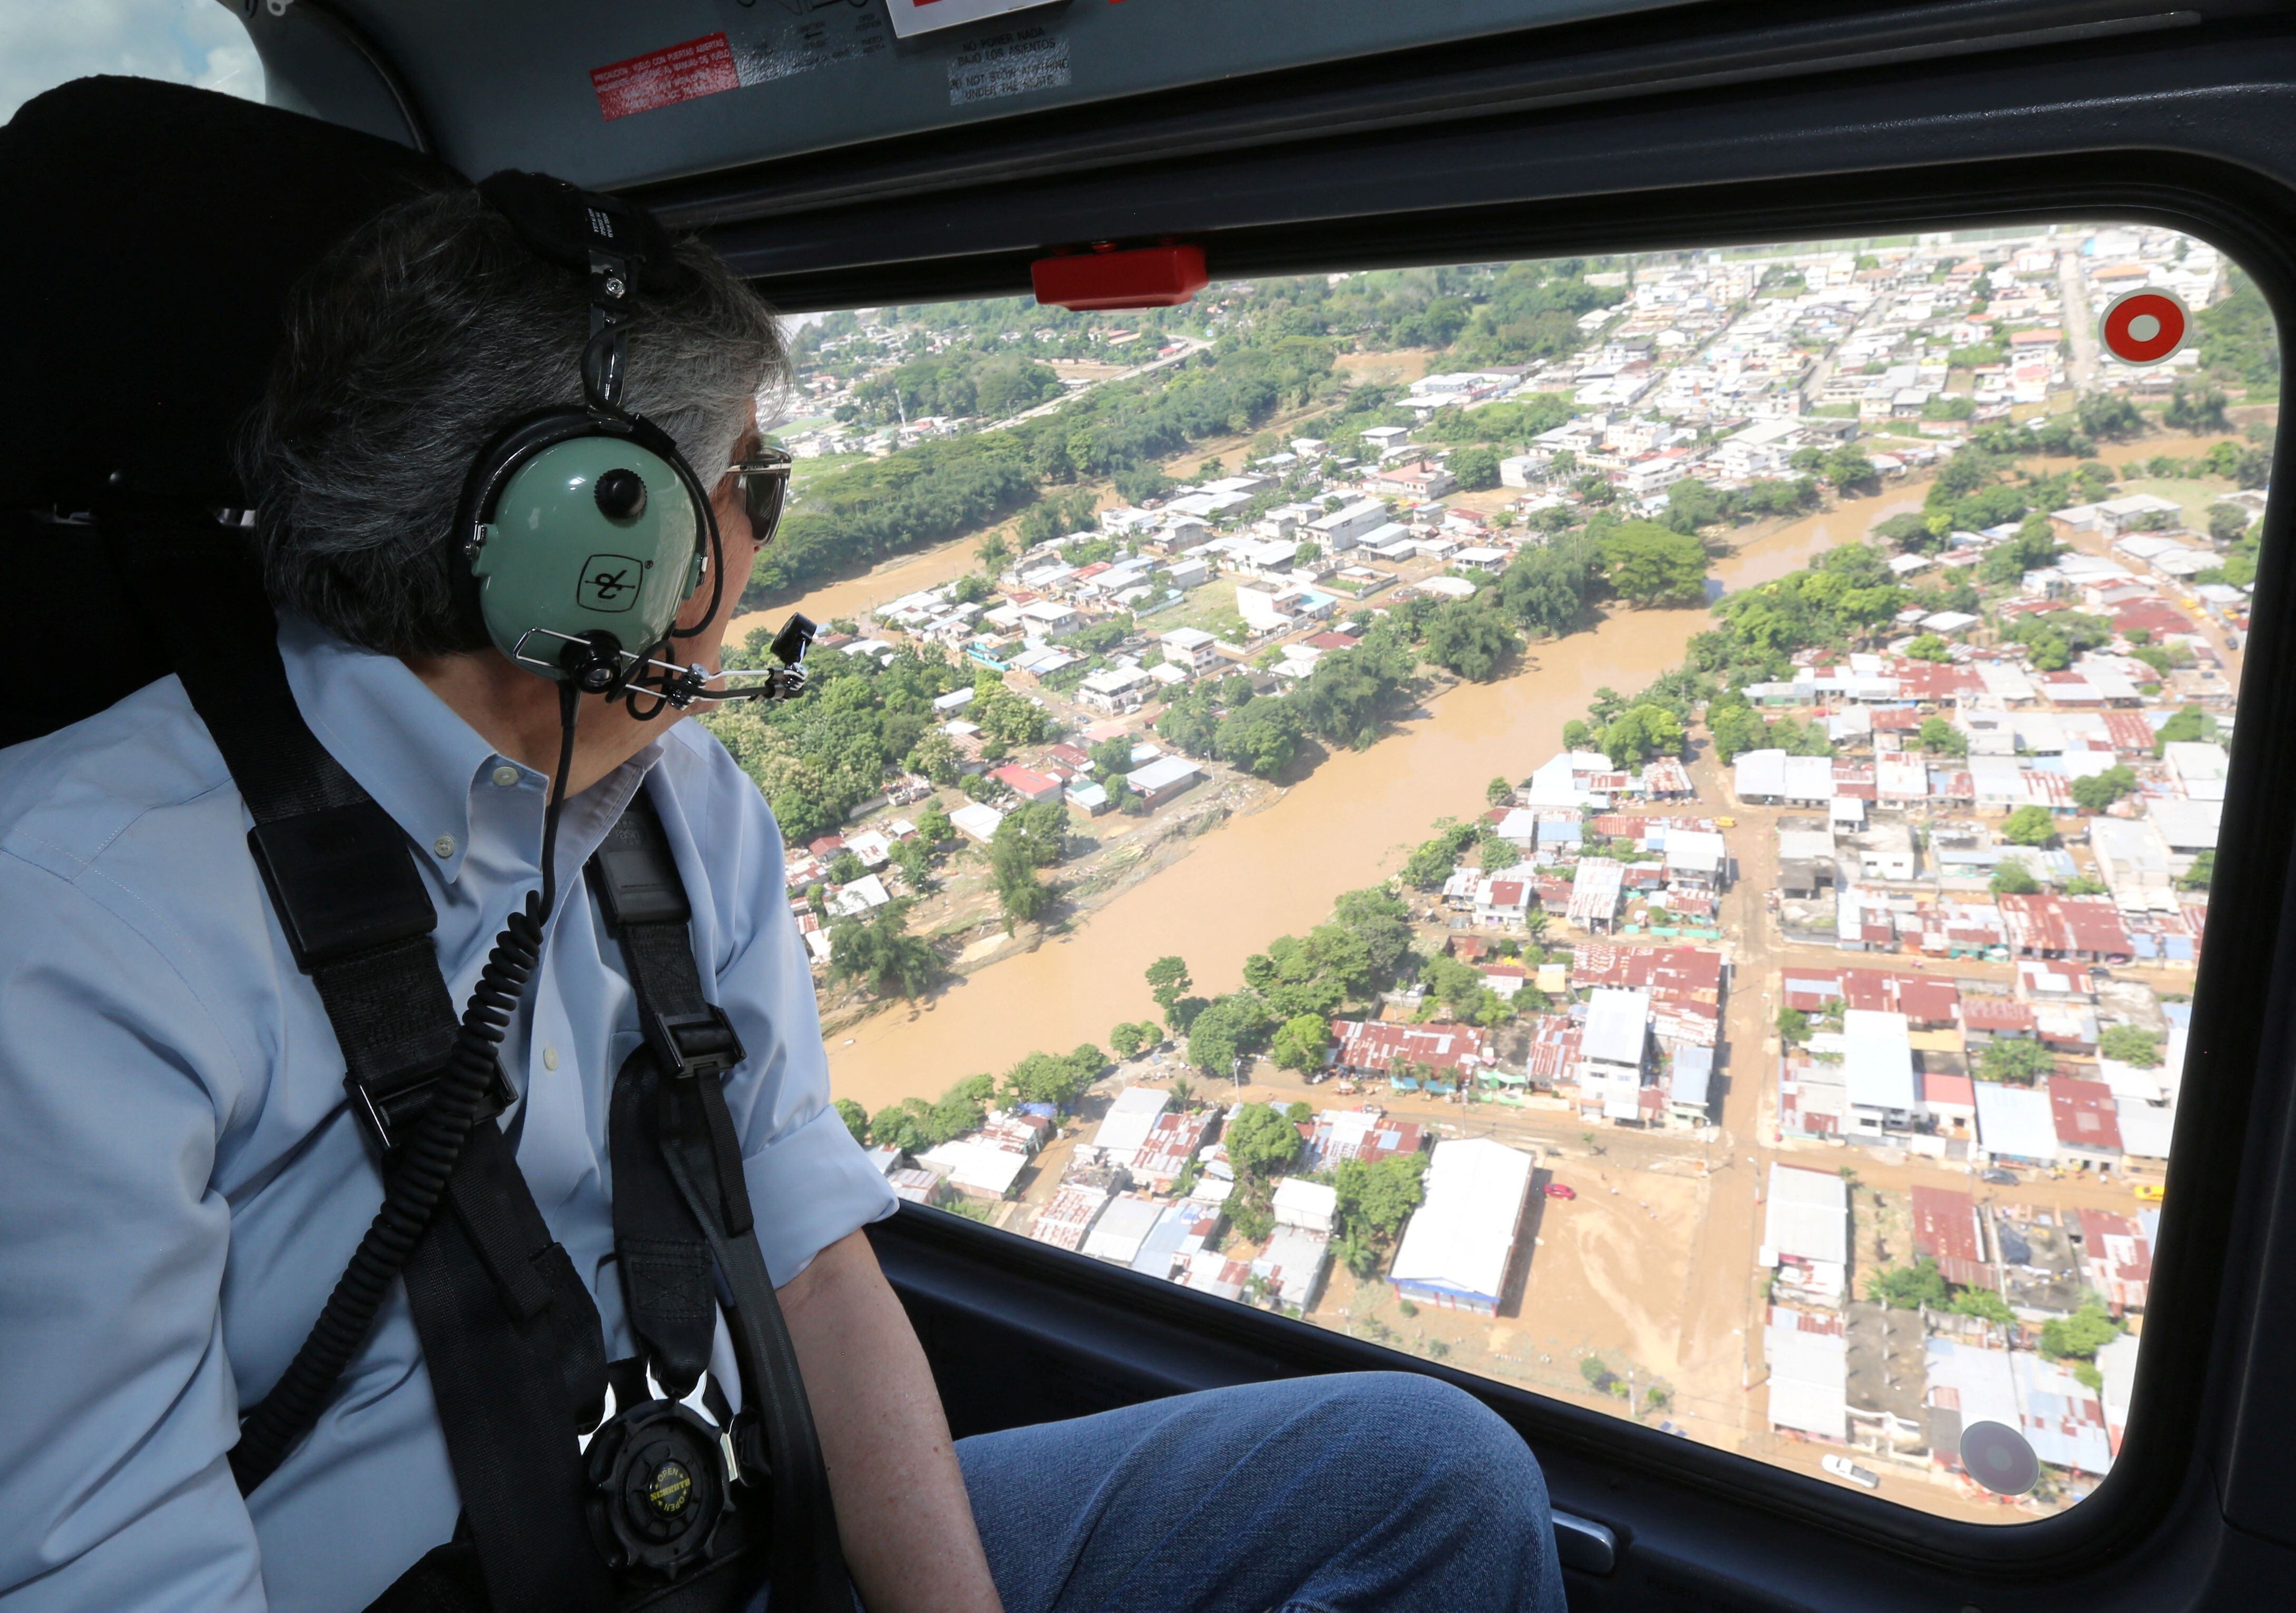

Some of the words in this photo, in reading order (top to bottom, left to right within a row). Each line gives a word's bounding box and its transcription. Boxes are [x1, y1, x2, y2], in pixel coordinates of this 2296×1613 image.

[963, 41, 977, 52] NO
[981, 33, 1013, 48] PONER
[1017, 27, 1045, 40] NADA
[653, 56, 666, 66] CON
[667, 47, 694, 61] PUERTAS
[696, 38, 724, 53] ABIERTAS
[674, 58, 698, 72] MANUAL
[698, 55, 708, 64] DE
[709, 48, 729, 61] VUELO
[958, 53, 981, 66] BAJO
[986, 48, 1004, 61] LOS
[1009, 38, 1056, 54] ASIENTOS
[967, 74, 985, 86] NOT
[965, 86, 996, 100] UNDER
[658, 1468, 678, 1482] OPEN
[664, 1496, 685, 1511] OPEN
